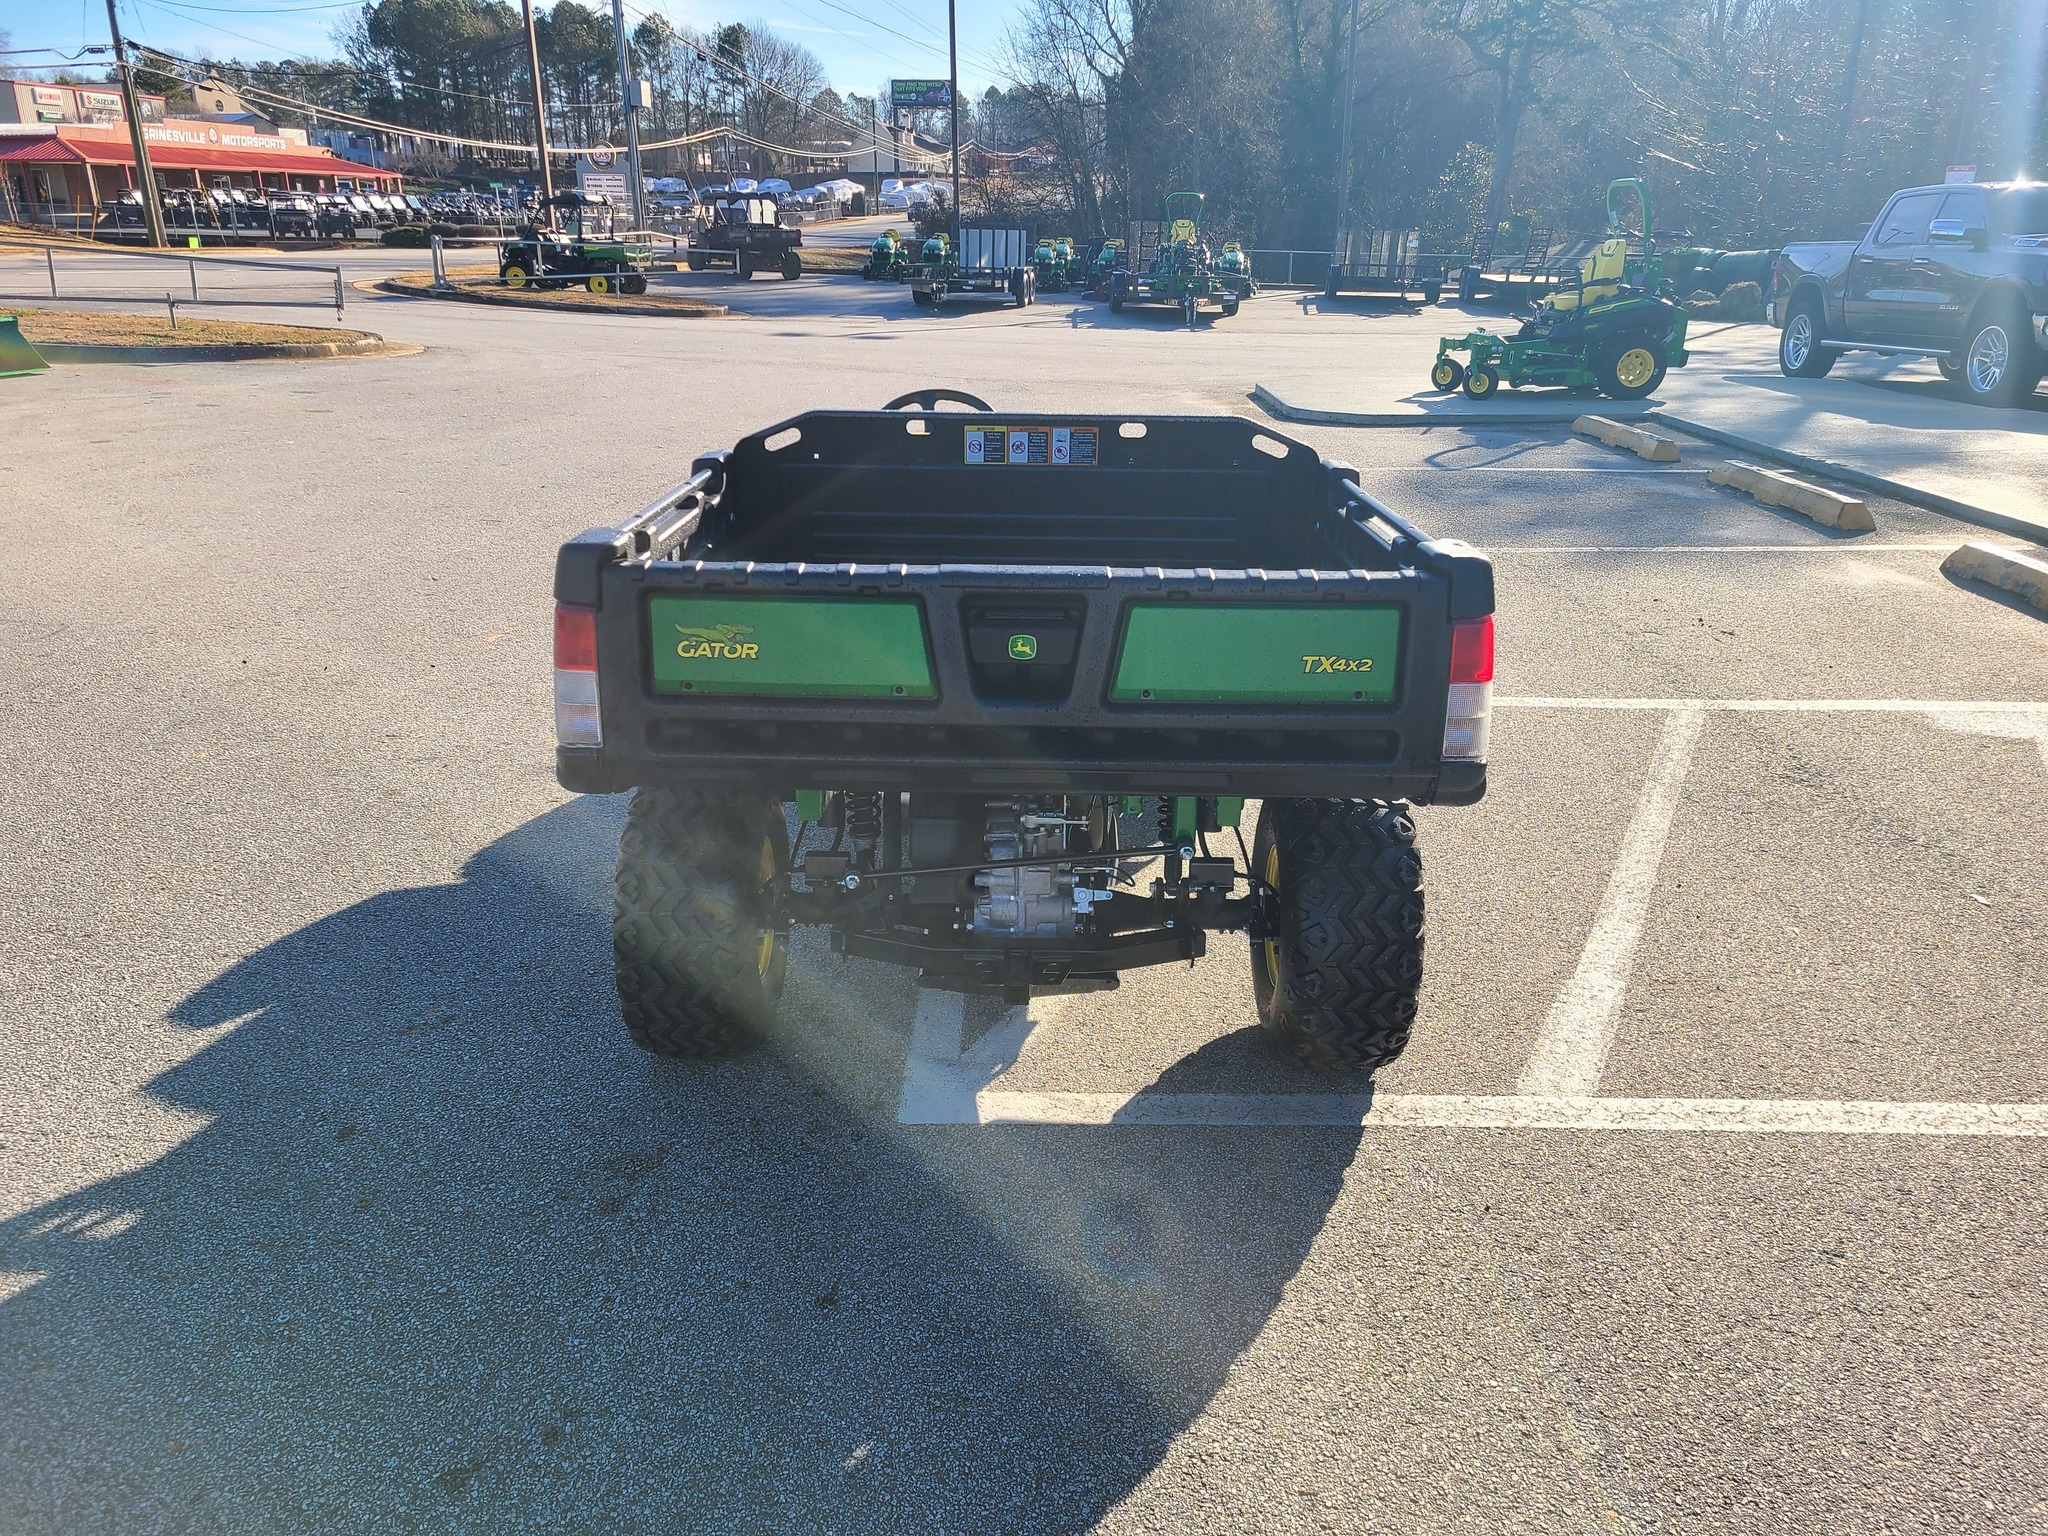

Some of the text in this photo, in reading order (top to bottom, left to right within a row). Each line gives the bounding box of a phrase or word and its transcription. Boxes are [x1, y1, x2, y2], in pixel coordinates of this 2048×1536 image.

[93, 97, 118, 106] SUZUKI
[221, 134, 286, 150] MOTORSPORTS
[677, 640, 759, 659] GATOR
